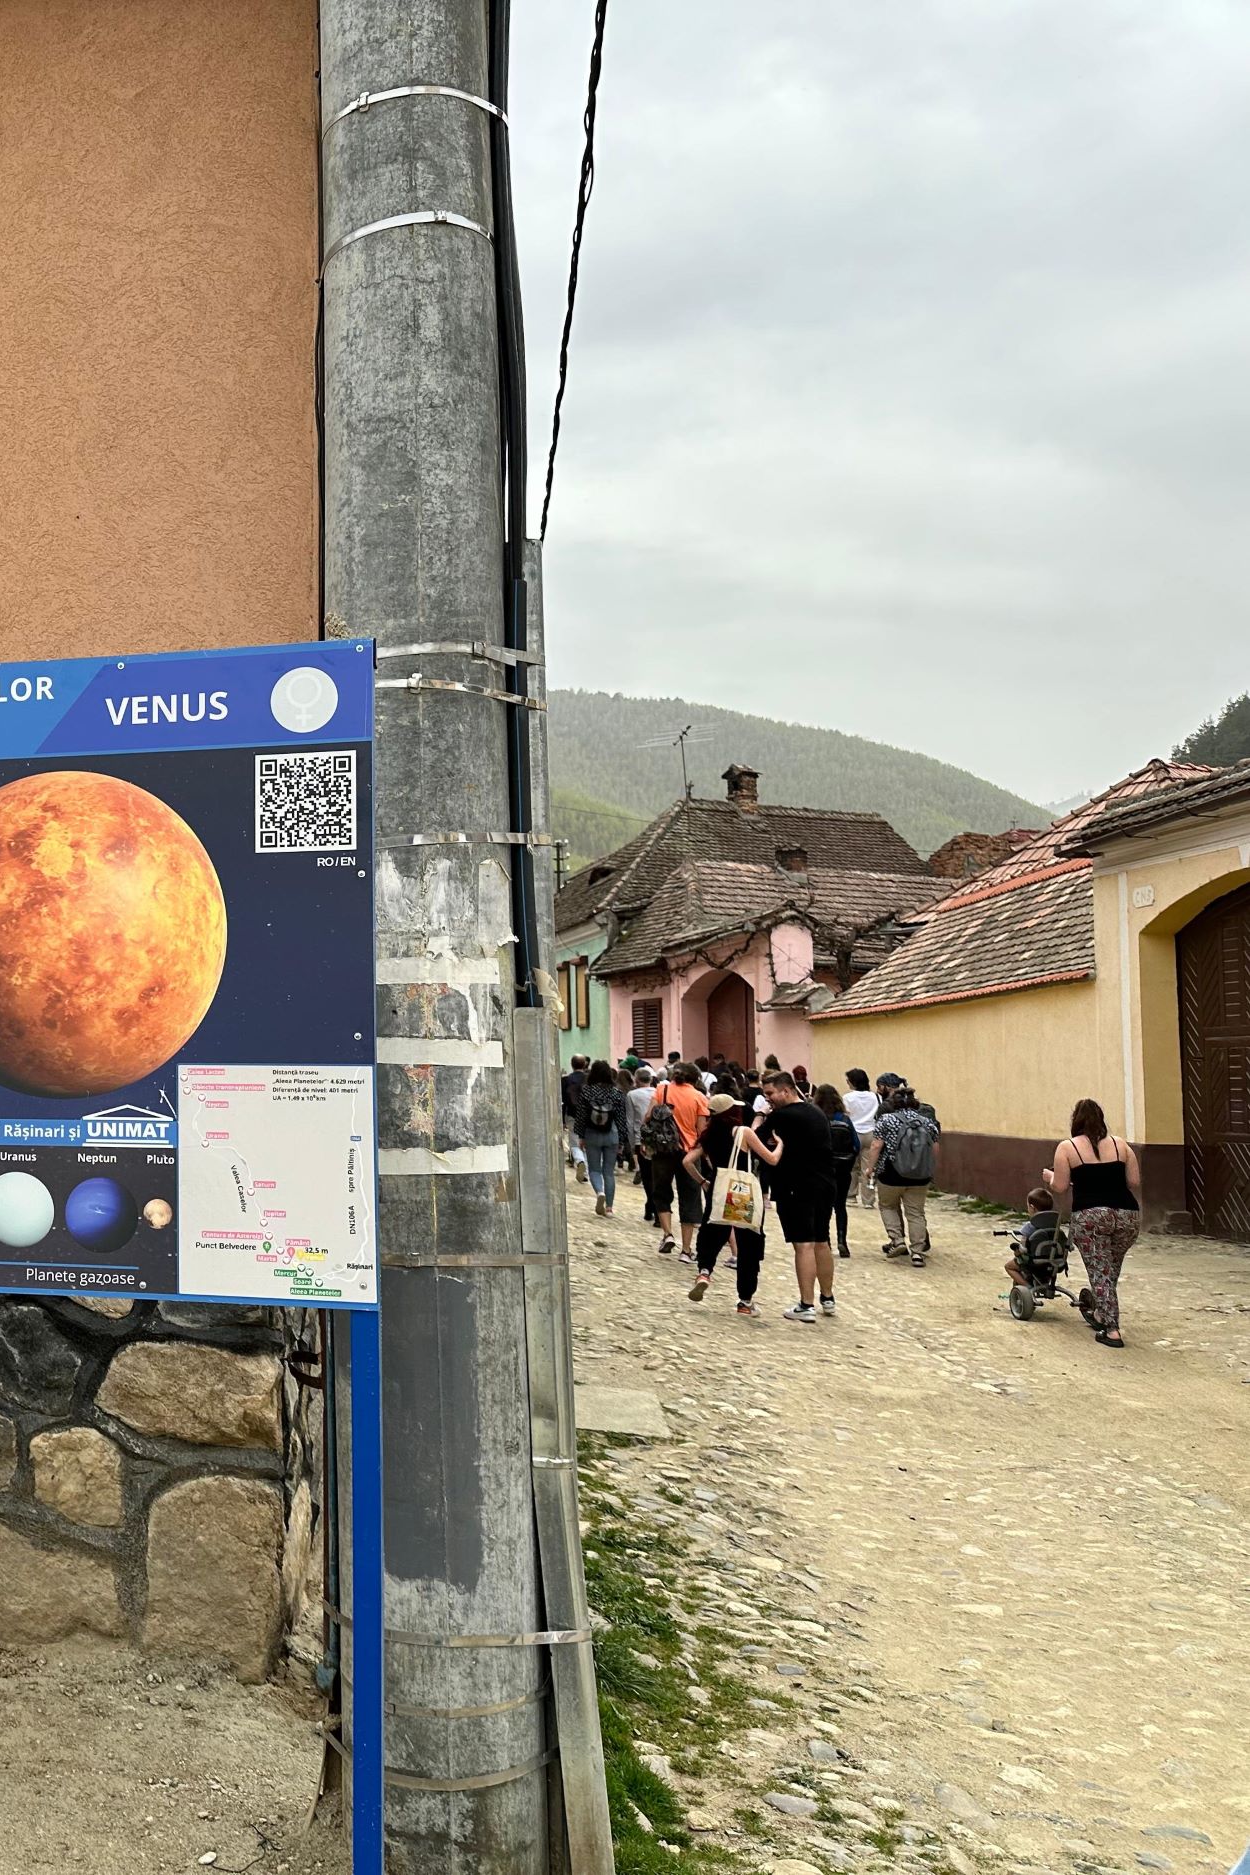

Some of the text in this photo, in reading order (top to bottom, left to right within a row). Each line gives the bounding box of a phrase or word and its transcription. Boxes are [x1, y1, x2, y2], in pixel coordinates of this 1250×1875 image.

[106, 692, 228, 725] VENUS
[3, 1123, 64, 1141] Rășinari
[68, 1124, 80, 1141] și
[87, 1122, 169, 1138] UNIMAT
[0, 1152, 37, 1162] Uranus
[77, 1153, 117, 1164] Neptun
[146, 1154, 175, 1165] Pluto
[195, 1241, 256, 1250] Punct Belvedere
[26, 1268, 134, 1288] Planete gazoase
